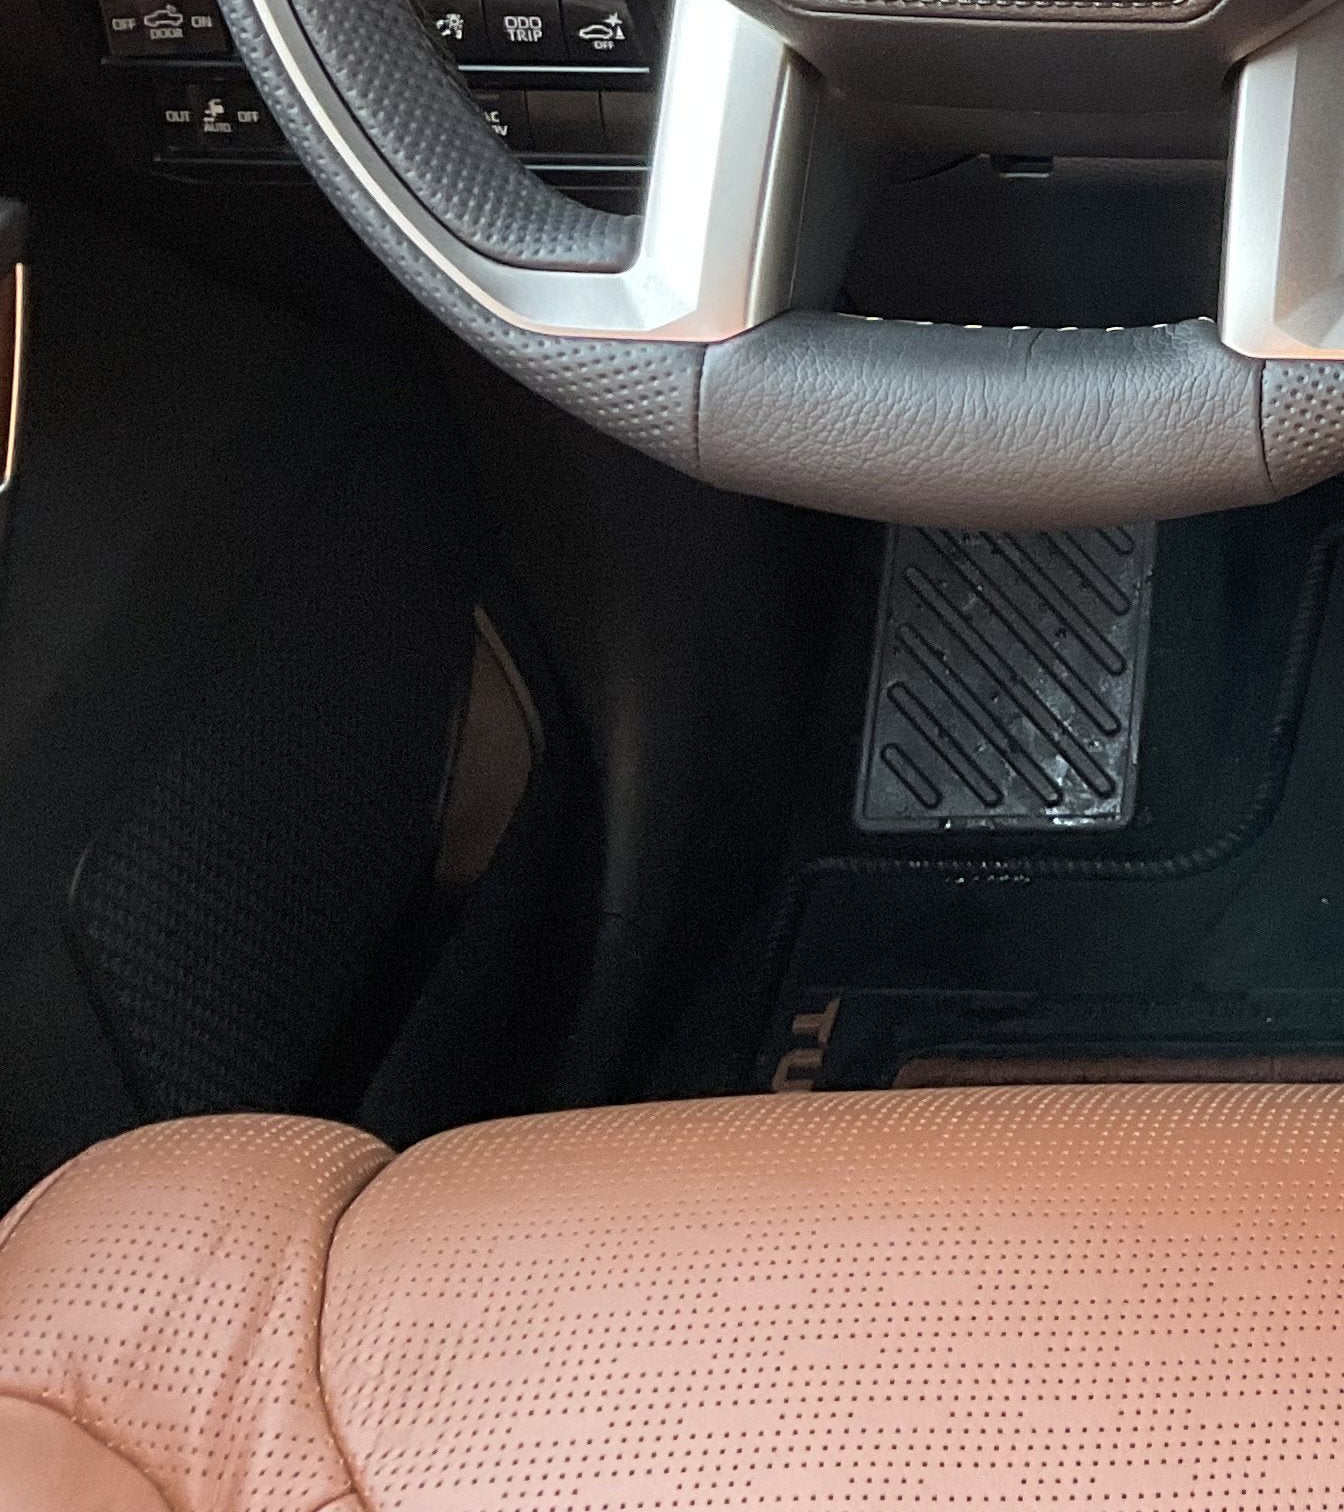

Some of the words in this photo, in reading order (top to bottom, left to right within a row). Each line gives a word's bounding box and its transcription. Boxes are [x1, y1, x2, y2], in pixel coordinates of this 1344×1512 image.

[111, 18, 137, 30] OFF
[191, 15, 213, 28] ON
[503, 15, 543, 29] ODO
[506, 28, 543, 42] TRIP
[593, 40, 615, 50] OFF
[165, 110, 191, 122] OUT
[237, 110, 260, 123] OFF
